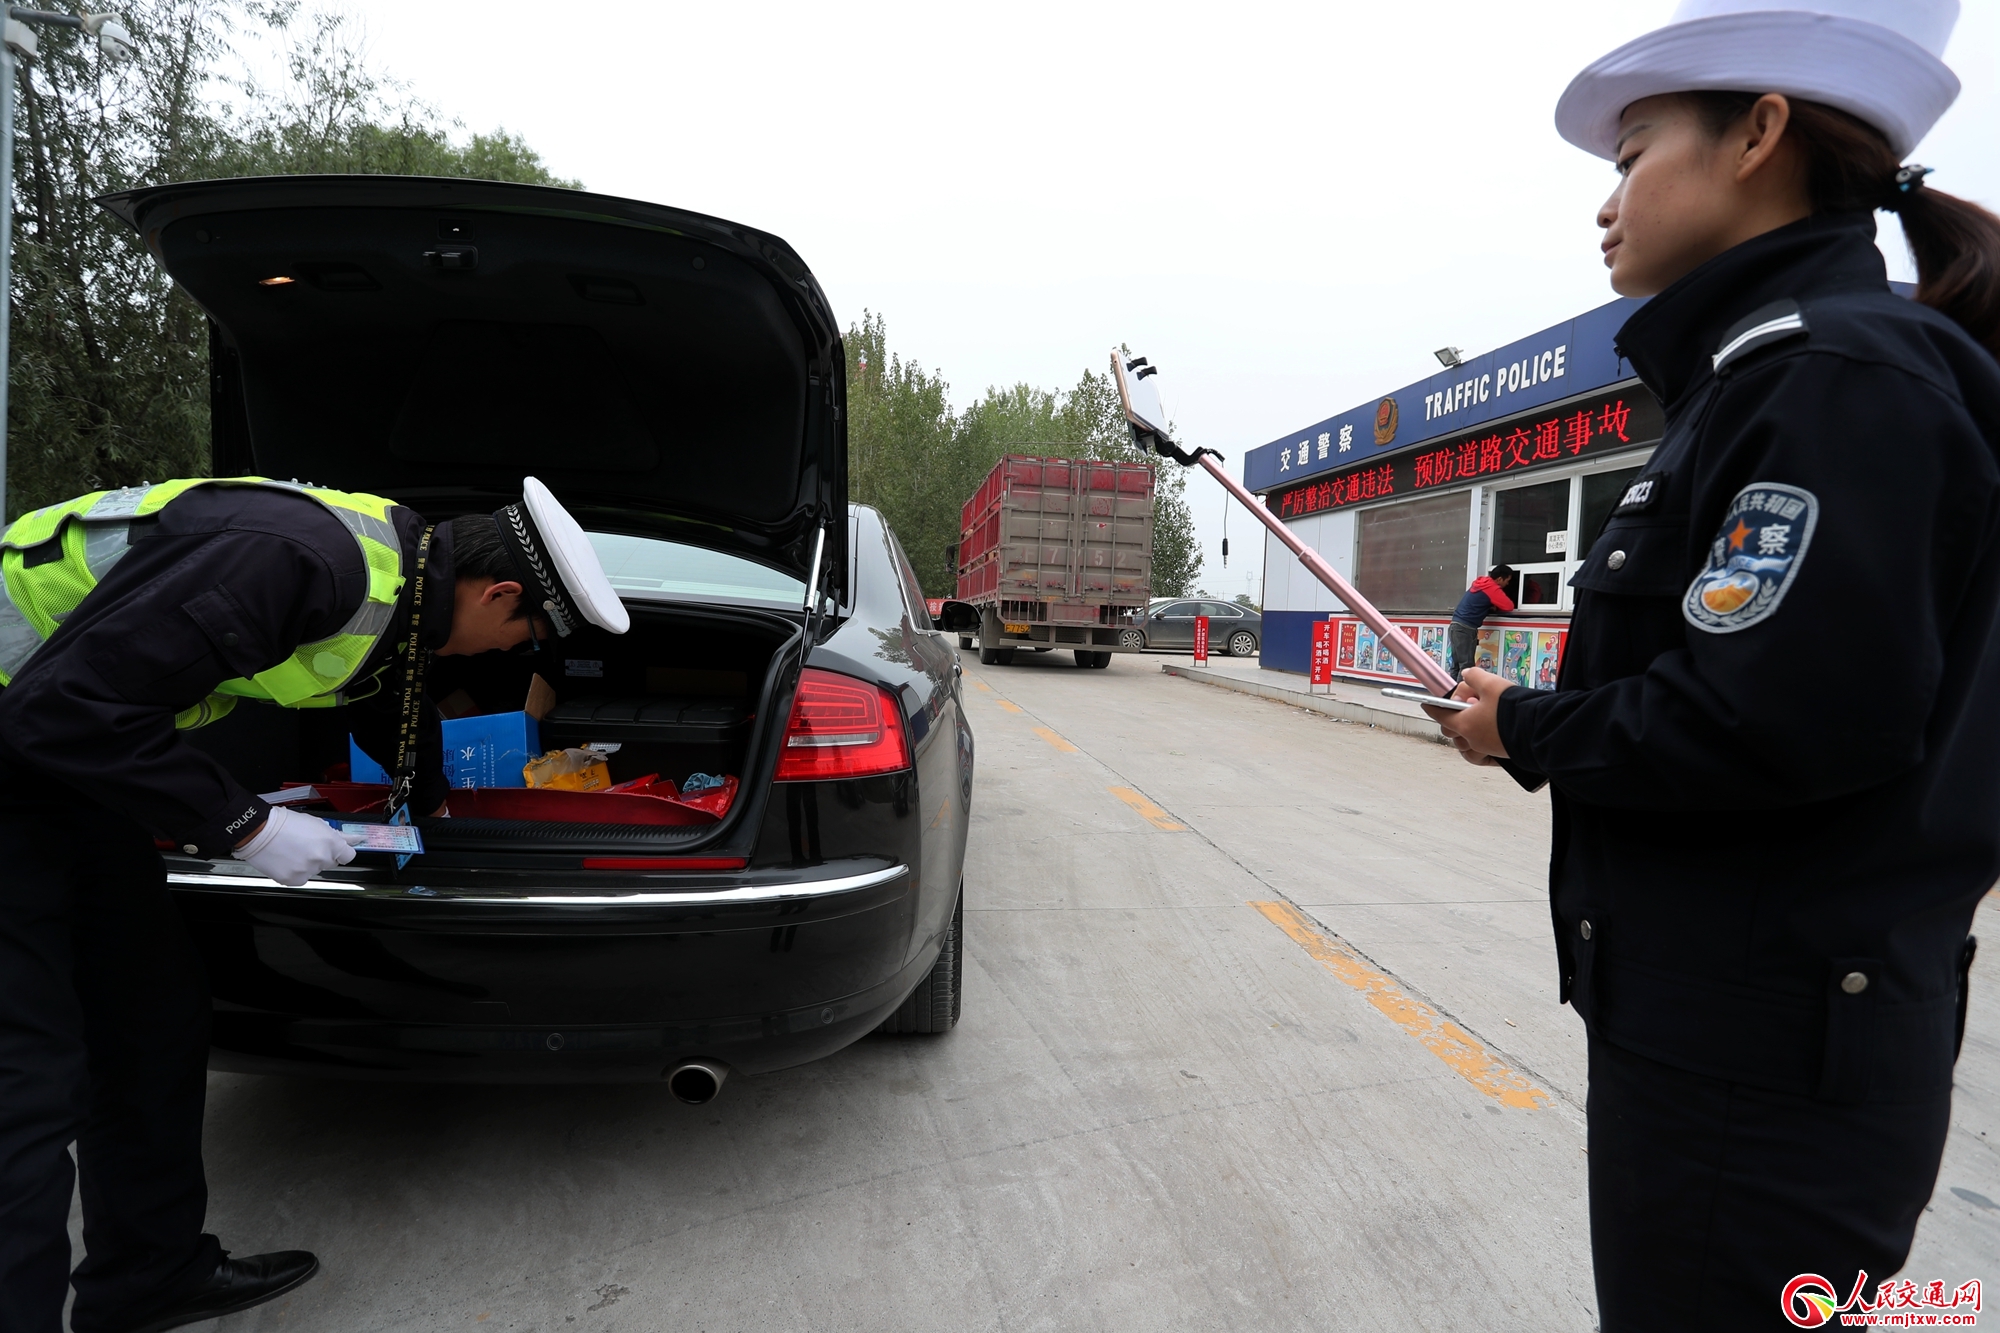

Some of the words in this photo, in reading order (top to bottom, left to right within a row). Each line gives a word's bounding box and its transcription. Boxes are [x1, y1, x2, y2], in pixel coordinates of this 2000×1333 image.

[1425, 373, 1490, 421] TRAFFIC
[1496, 345, 1567, 398] POLICE
[1280, 424, 1353, 473] 交通警察
[1280, 463, 1394, 518] 严厉整治交通违法
[1414, 400, 1631, 488] 预防道路交通事故
[1757, 523, 1791, 555] 察
[414, 576, 424, 606] POLICE
[1006, 624, 1030, 633] F7752
[408, 632, 418, 662] POLICE
[1322, 624, 1331, 665] 开车不喝酒
[1314, 641, 1323, 682] 喝酒不开车
[402, 687, 412, 716] POLICE
[410, 700, 420, 728] POLICE
[225, 805, 257, 834] POLICE
